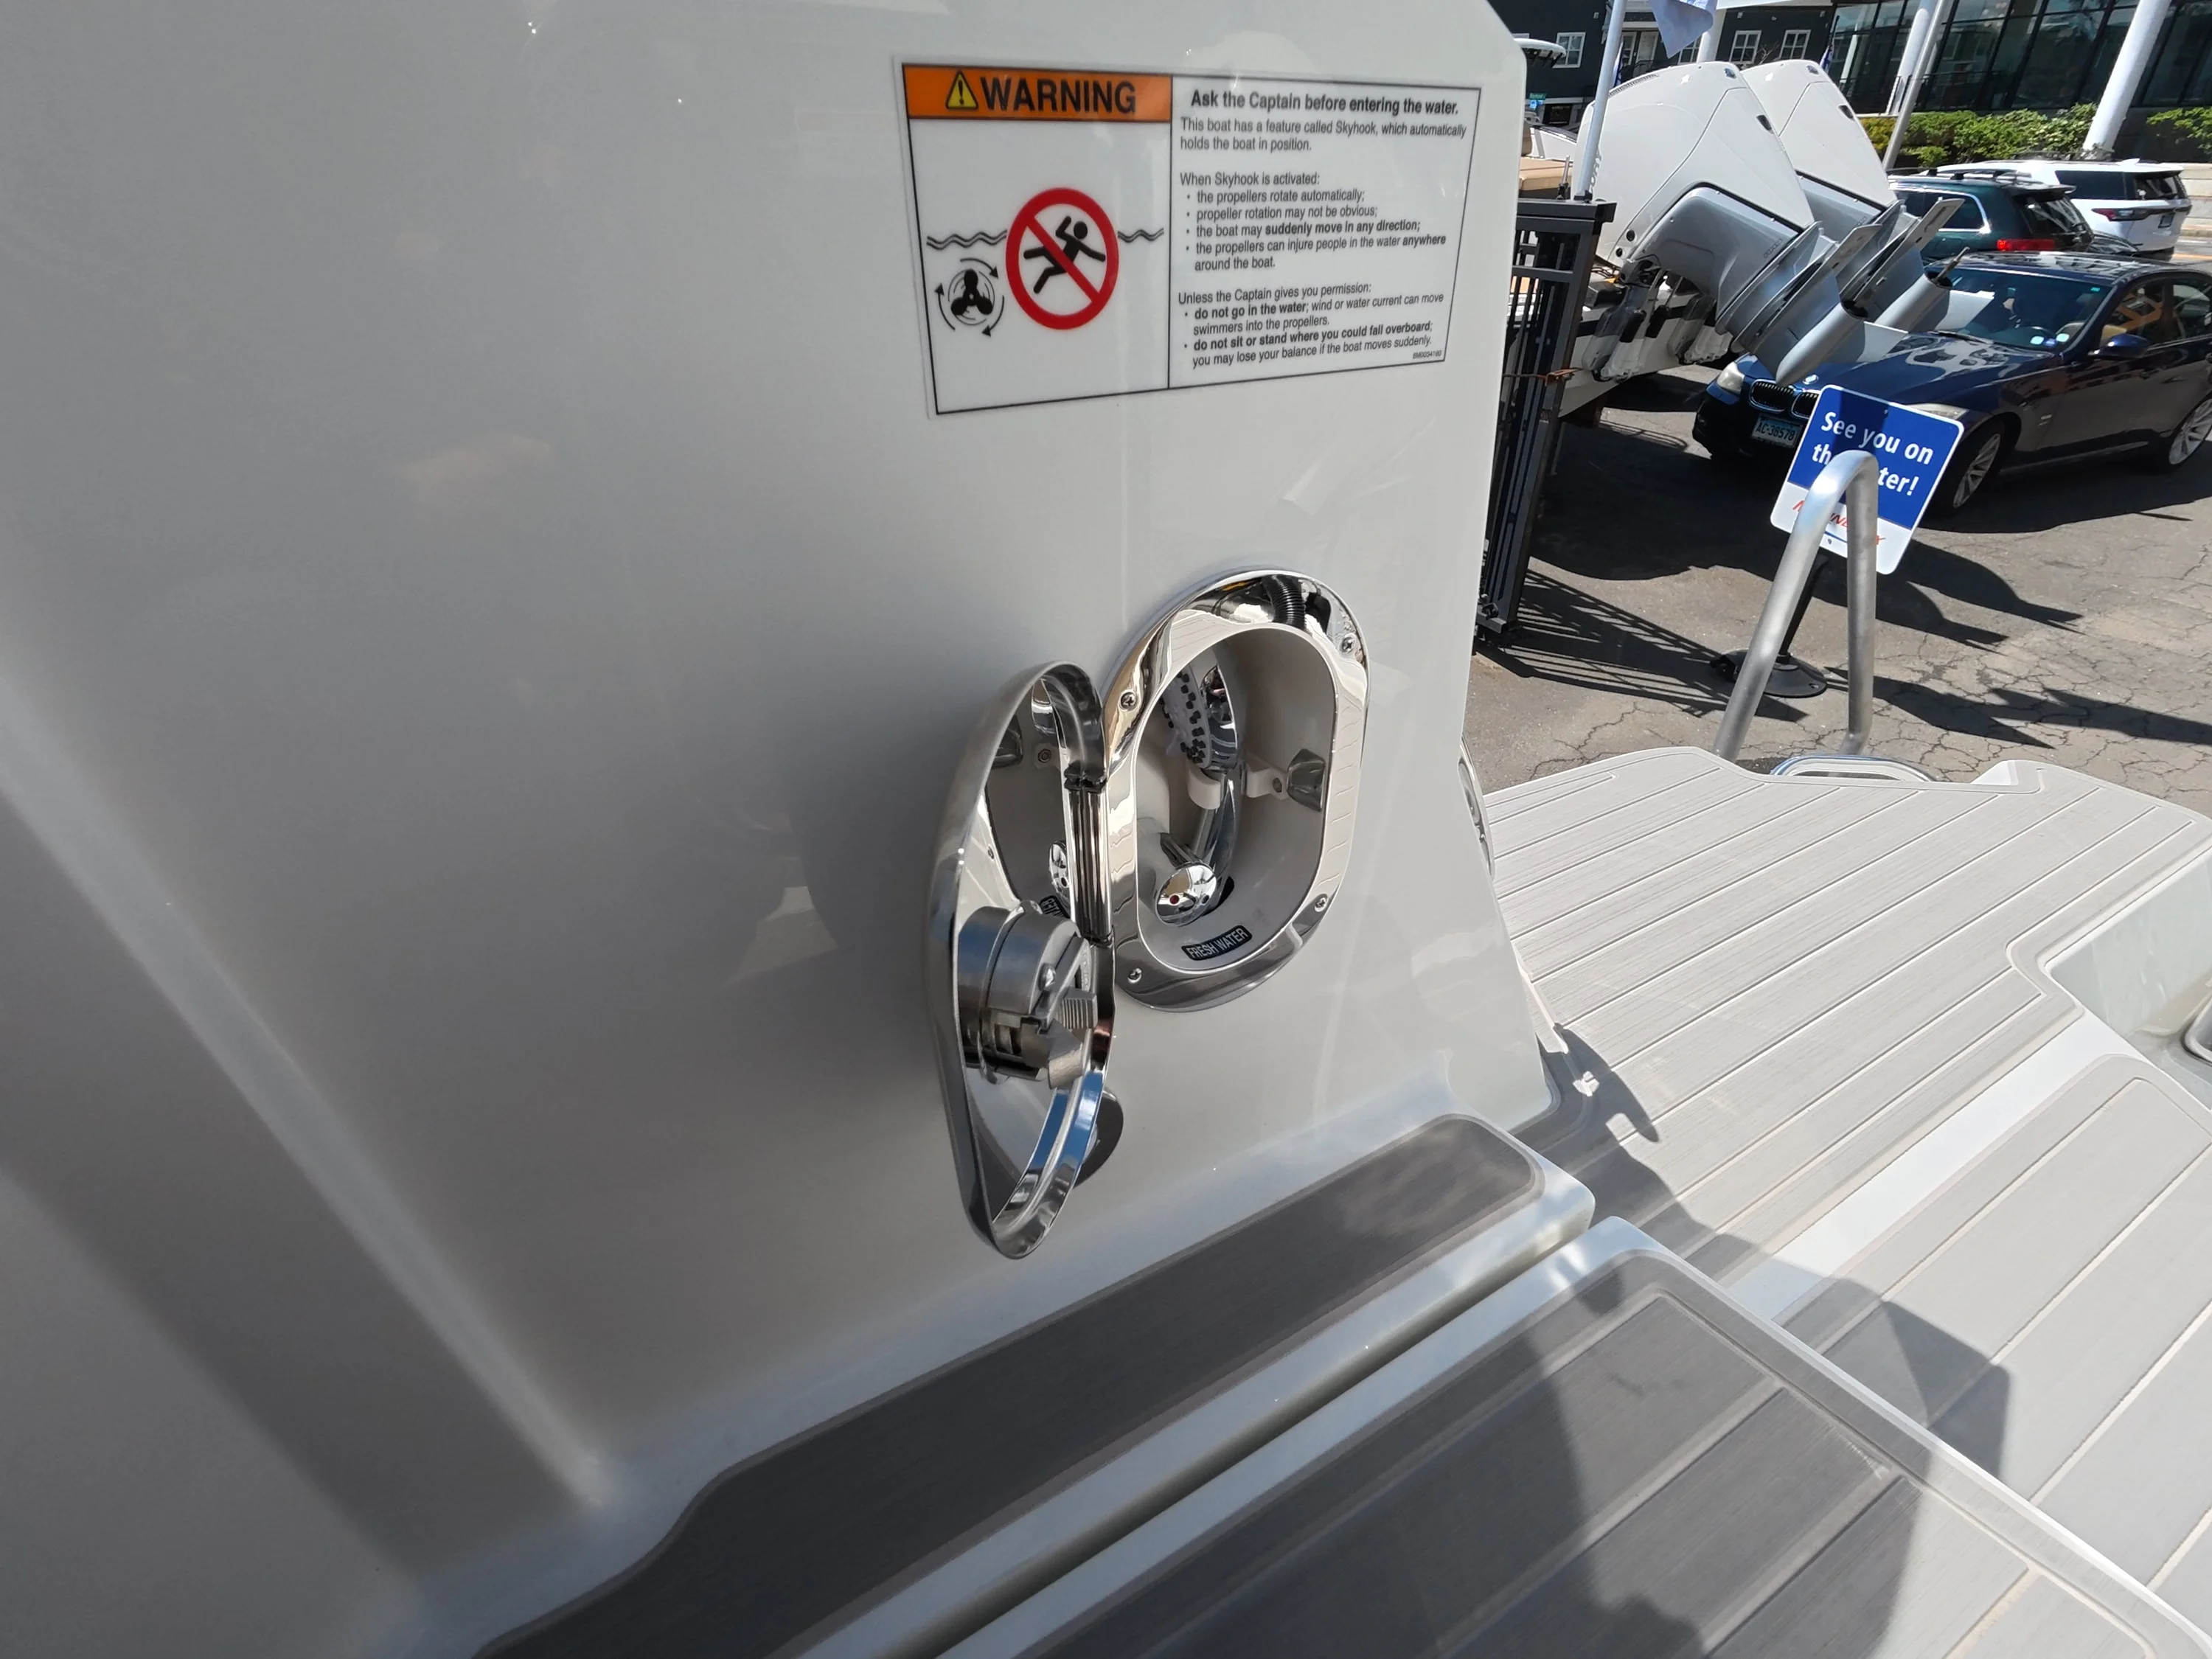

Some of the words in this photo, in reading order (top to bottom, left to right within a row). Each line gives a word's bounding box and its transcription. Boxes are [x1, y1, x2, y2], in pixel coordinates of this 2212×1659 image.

[980, 77, 1136, 114] WARNING
[1191, 89, 1218, 106] Ask
[1223, 91, 1245, 108] the
[1249, 91, 1301, 112] Captain
[1305, 94, 1346, 111] before
[1349, 96, 1400, 116] entering
[1403, 98, 1422, 114] the
[1425, 100, 1458, 114] water.
[1180, 116, 1204, 131] This
[1207, 117, 1231, 132] boat
[1234, 118, 1253, 132] has
[1256, 122, 1262, 132] a
[1266, 119, 1301, 133] feature
[1304, 119, 1332, 133] called
[1335, 119, 1378, 139] Skyhook,
[1382, 122, 1407, 136] which
[1410, 123, 1467, 139] automatically
[1180, 136, 1209, 150] holds
[1213, 137, 1229, 150] the
[1233, 137, 1256, 150] boat
[1259, 137, 1267, 150] in
[1270, 137, 1311, 153] position.
[1180, 173, 1211, 186] When
[1214, 172, 1259, 188] Skyhook
[1262, 172, 1270, 184] is
[1273, 172, 1320, 185] activated:
[1197, 189, 1213, 203] the
[1217, 189, 1267, 206] propellers
[1270, 190, 1298, 202] rotate
[1301, 189, 1364, 204] automatically;
[1197, 207, 1242, 222] propeller
[1245, 206, 1281, 219] rotation
[1285, 208, 1305, 220] may
[1308, 206, 1323, 218] not
[1325, 205, 1337, 218] be
[1340, 204, 1377, 218] obvious;
[1197, 225, 1212, 237] the
[1216, 224, 1238, 237] boat
[1241, 225, 1262, 238] may
[1265, 222, 1312, 237] suddenly
[1315, 223, 1342, 234] move
[1345, 220, 1354, 233] in
[1357, 222, 1374, 234] any
[1377, 219, 1420, 232] direction;
[1196, 242, 1212, 254] the
[1215, 240, 1264, 257] propellers
[1267, 241, 1284, 251] can
[1287, 238, 1313, 253] injure
[1316, 237, 1346, 252] people
[1350, 236, 1357, 248] in
[1360, 235, 1374, 248] the
[1377, 235, 1400, 247] water
[1402, 234, 1446, 248] anywhere
[1194, 258, 1230, 271] around
[1234, 257, 1248, 269] the
[1251, 256, 1275, 268] boat.
[1178, 292, 1213, 305] Unless
[1216, 290, 1231, 302] the
[1234, 288, 1271, 302] Captain
[1274, 286, 1299, 302] gives
[1302, 287, 1318, 299] you
[1321, 282, 1371, 298] permission:
[1194, 307, 1208, 319] do
[1211, 306, 1228, 319] not
[1231, 307, 1245, 319] go
[1248, 304, 1257, 316] in
[1260, 304, 1276, 315] the
[1279, 302, 1309, 313] water;
[1312, 299, 1332, 311] wind
[1335, 300, 1343, 310] or
[1346, 297, 1370, 309] water
[1372, 294, 1402, 307] current
[1404, 294, 1419, 305] can
[1422, 293, 1444, 304] move
[1193, 322, 1242, 335] swimmers
[1246, 320, 1262, 332] into
[1266, 319, 1280, 330] the
[1283, 316, 1329, 331] propellers.
[1194, 340, 1207, 351] do
[1211, 337, 1228, 349] not
[1231, 335, 1242, 348] sit
[1246, 337, 1256, 347] or
[1259, 333, 1287, 345] stand
[1290, 330, 1319, 344] where
[1321, 330, 1338, 343] you
[1341, 327, 1367, 338] could
[1370, 324, 1383, 336] fall
[1385, 321, 1433, 334] overboard;
[1193, 356, 1210, 369] you
[1214, 354, 1234, 366] may
[1237, 351, 1256, 362] lose
[1259, 349, 1279, 363] your
[1281, 345, 1317, 358] balance
[1320, 344, 1326, 355] if
[1328, 341, 1340, 354] the
[1343, 340, 1362, 352] boat
[1365, 338, 1391, 350] moves
[1394, 334, 1432, 348] suddenly.
[1821, 411, 1856, 439] See
[1858, 428, 1901, 454] you
[1905, 443, 1934, 465] on
[1812, 443, 1832, 465] th
[1878, 467, 1919, 496] ter!
[1186, 942, 1219, 958] FRESH
[1214, 928, 1248, 950] WATER
